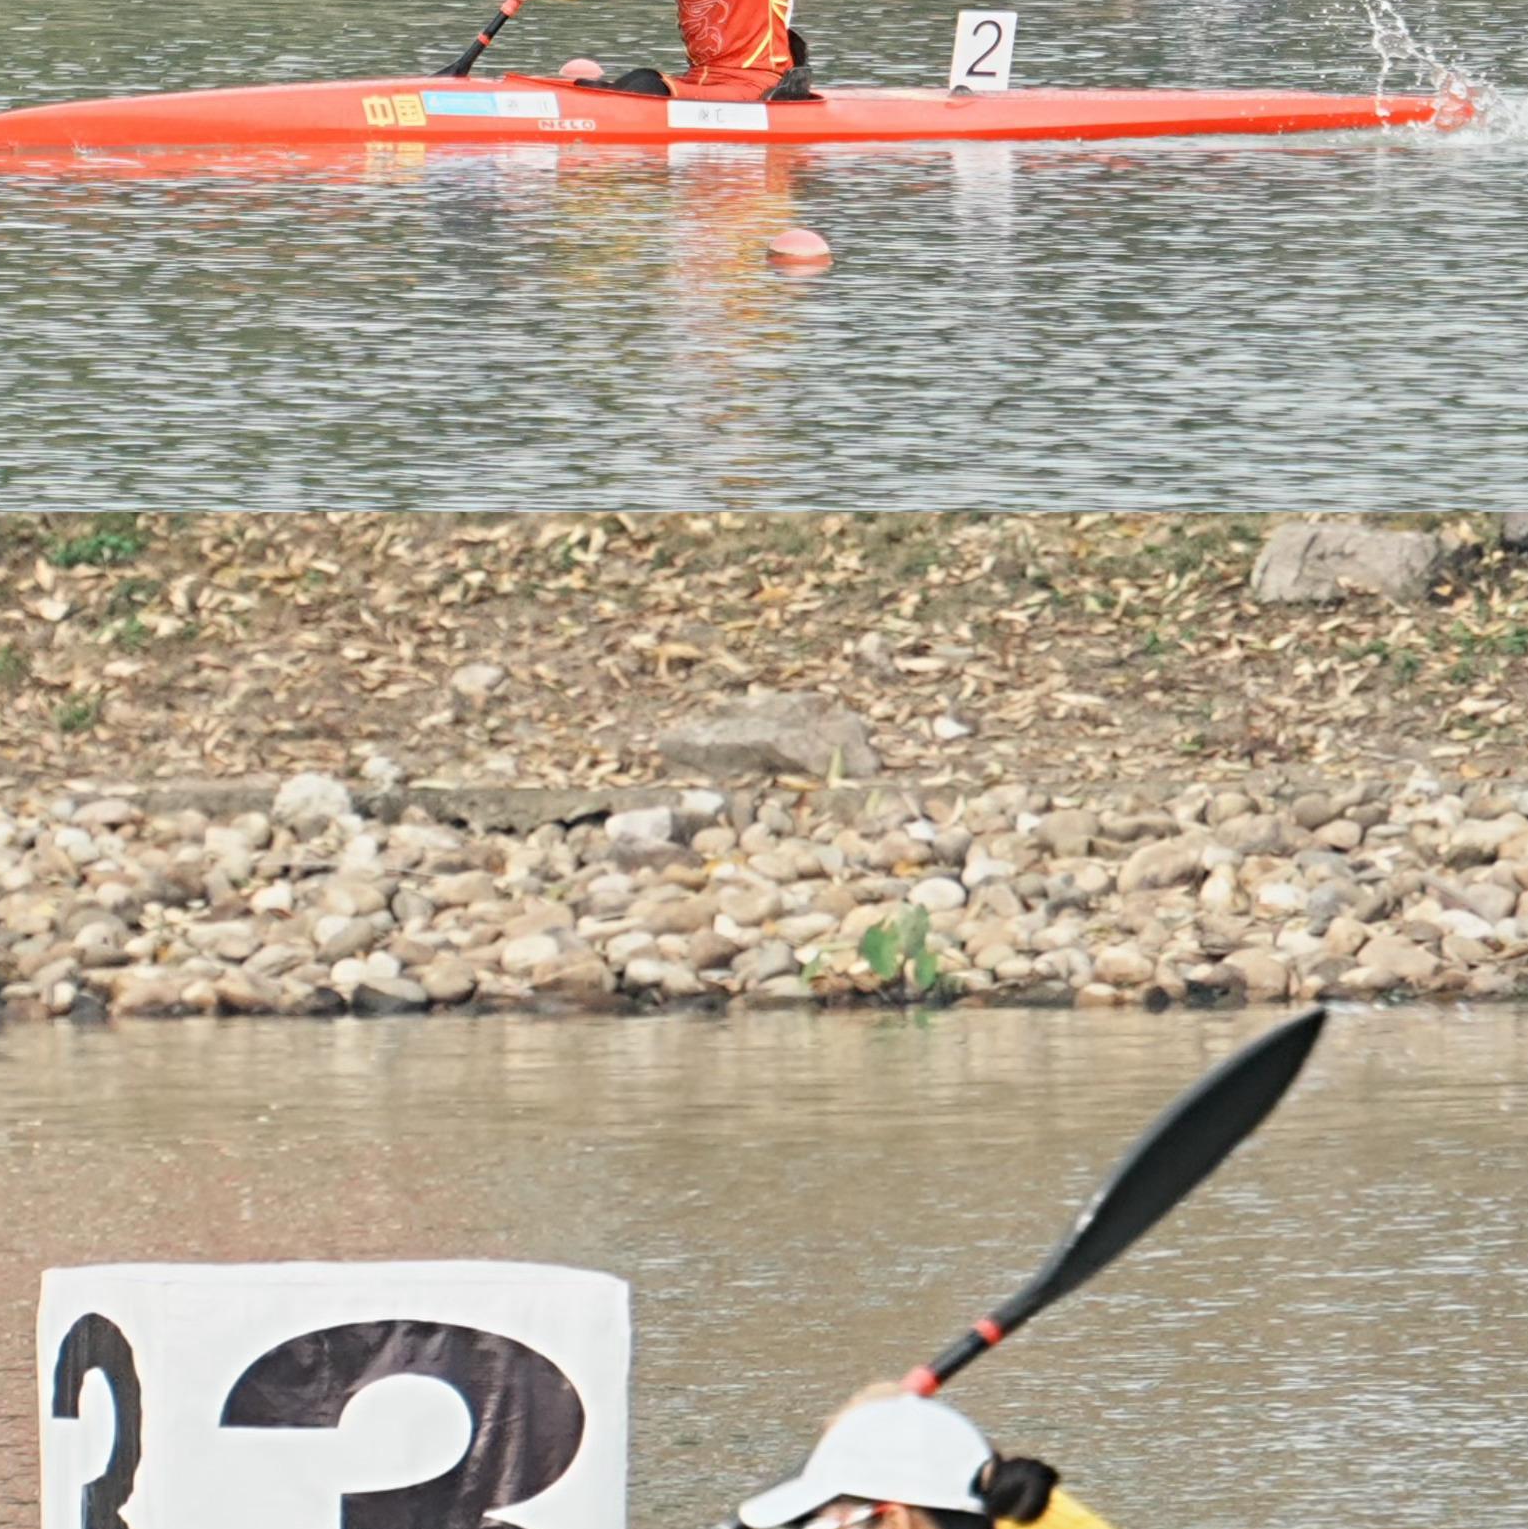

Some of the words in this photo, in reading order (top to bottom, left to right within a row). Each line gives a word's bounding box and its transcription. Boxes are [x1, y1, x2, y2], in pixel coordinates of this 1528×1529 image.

[966, 20, 1003, 77] 2
[362, 95, 427, 127] 中国
[541, 120, 594, 131] NELO
